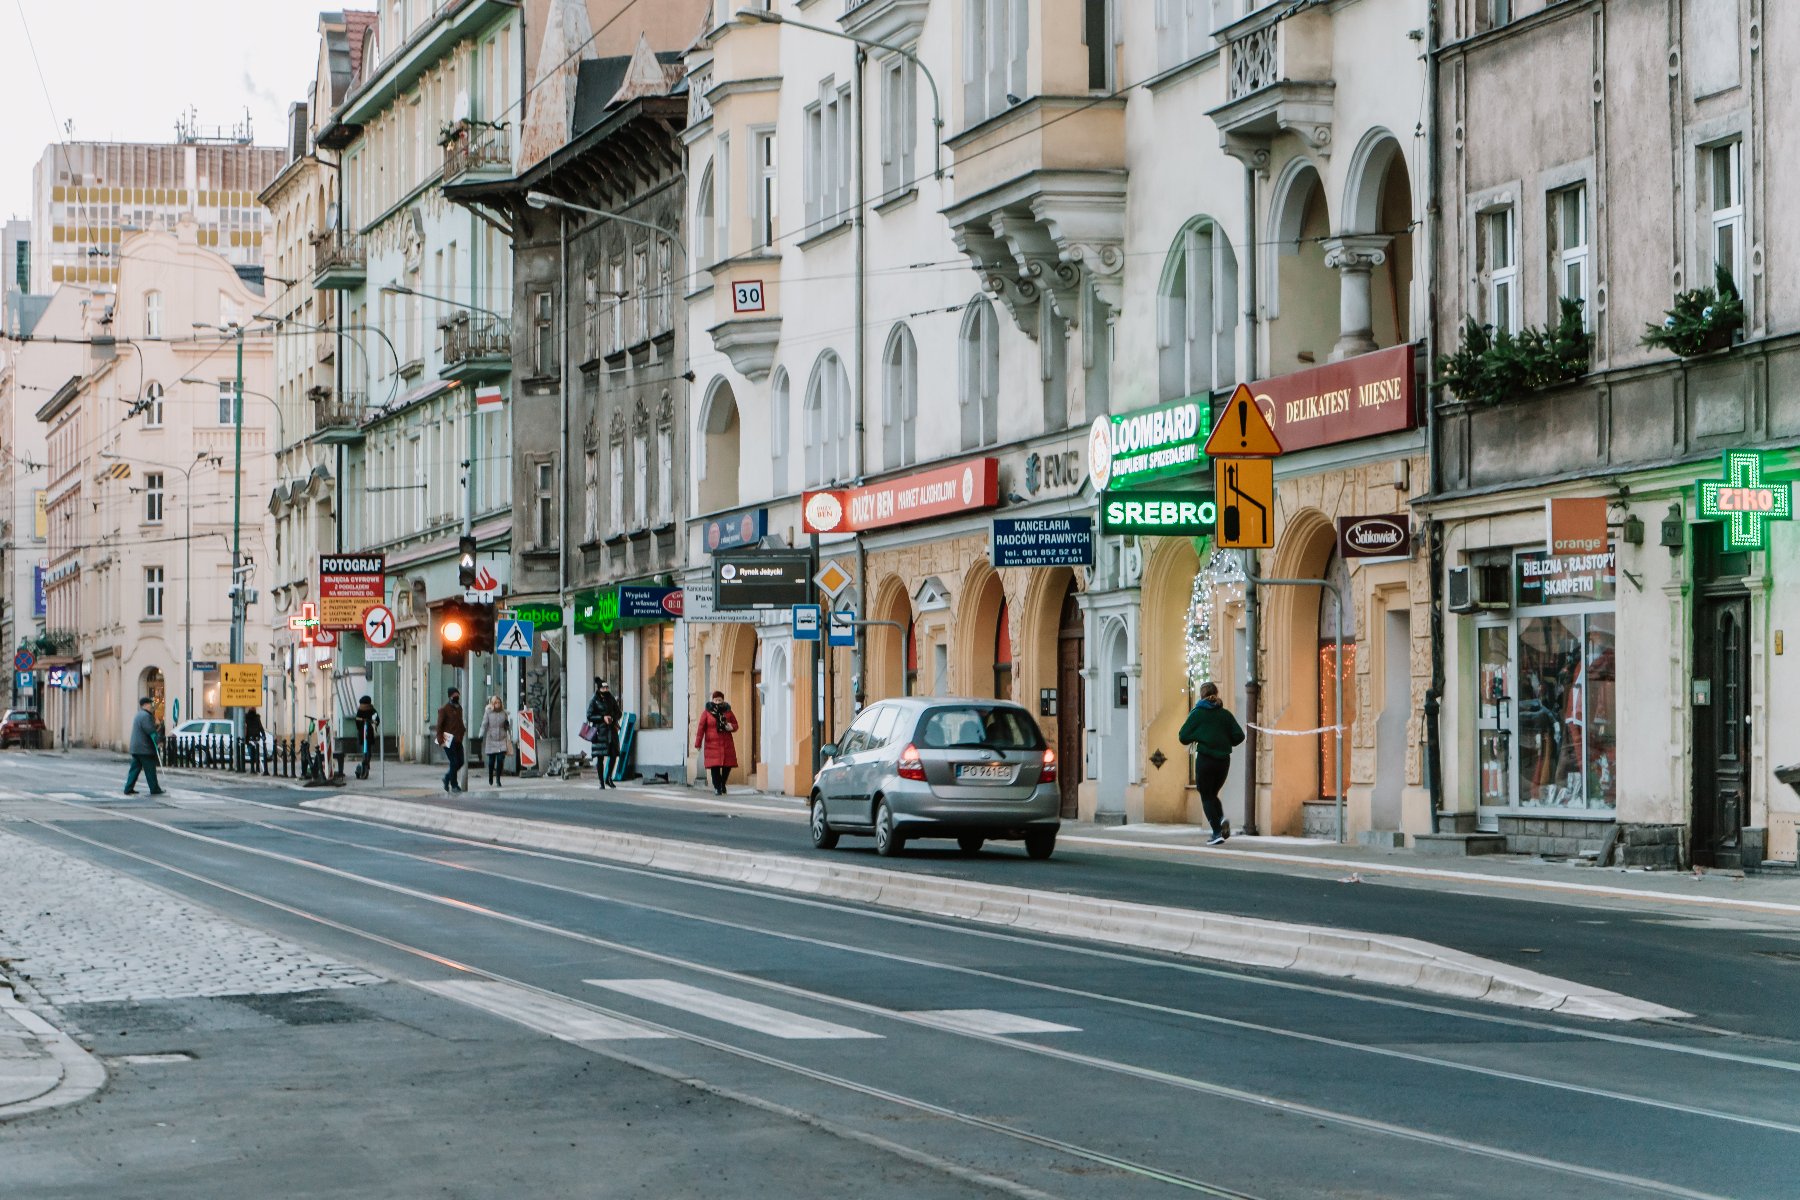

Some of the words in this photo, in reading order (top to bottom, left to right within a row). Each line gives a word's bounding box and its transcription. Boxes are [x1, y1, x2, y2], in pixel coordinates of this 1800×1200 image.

[738, 288, 760, 304] 30
[1286, 388, 1352, 424] DELIKATESY
[1359, 377, 1402, 410] MIĘSNE
[1111, 403, 1198, 456] LOOMBARD
[1112, 453, 1149, 477] SKUPUJEMY
[1149, 443, 1197, 469] SPRZEDAJEMY
[1044, 451, 1079, 489] FMG
[852, 490, 875, 525] DUŻY
[876, 490, 894, 520] BEN
[897, 487, 919, 511] MARKET
[919, 480, 957, 506] ALKOHOLOWY
[817, 510, 833, 518] BEN
[1107, 501, 1217, 525] SREBRO
[1014, 520, 1071, 532] KANCELARIA
[996, 532, 1036, 546] RADCÓW
[1038, 532, 1090, 544] PRAWNYCH
[1355, 525, 1398, 544] Sobkowiak
[1554, 538, 1601, 551] orange
[1005, 549, 1020, 557] tel.
[1050, 556, 1064, 564] 147
[322, 559, 381, 572] FOTOGRAF
[740, 567, 759, 576] Rynek
[1523, 558, 1562, 577] BIELIZNA
[1569, 552, 1615, 572] RAJSTOPY
[1544, 575, 1594, 596] SKARPETKI
[625, 591, 650, 600] Wypieki
[633, 607, 662, 615] pracowni
[202, 642, 258, 657] ORN
[21, 673, 30, 685] P
